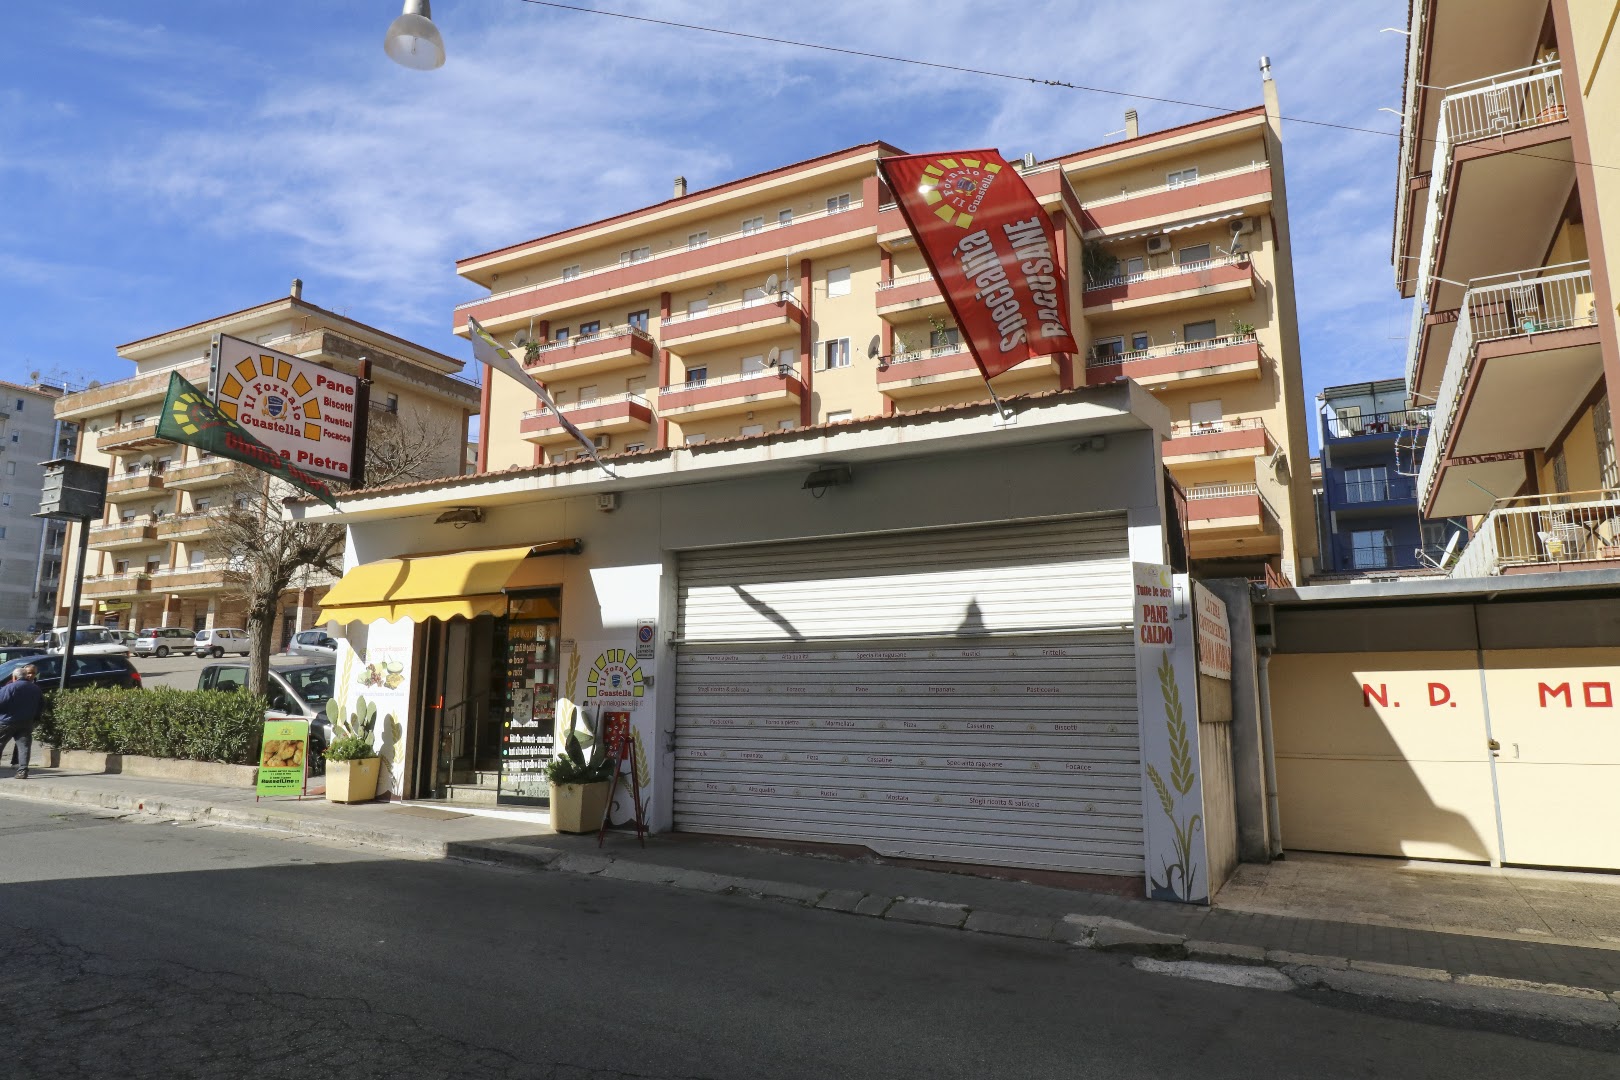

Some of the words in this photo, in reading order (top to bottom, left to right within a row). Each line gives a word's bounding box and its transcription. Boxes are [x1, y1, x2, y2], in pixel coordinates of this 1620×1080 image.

[944, 168, 980, 198] Fornaio
[968, 174, 995, 213] Guastella
[1002, 216, 1068, 338] RAGUSANE
[316, 374, 355, 396] Pane
[243, 395, 257, 409] Il
[252, 382, 302, 421] Fornaio
[323, 396, 354, 414] Biscotti
[240, 412, 302, 438] Guastella
[324, 414, 353, 429] Rustici
[279, 448, 291, 461] a
[297, 449, 349, 473] Pietra
[1136, 584, 1152, 597] Tutte
[1152, 586, 1159, 597] le
[1159, 587, 1172, 598] sere
[1142, 604, 1169, 624] PANE
[1140, 625, 1173, 645] CALDO
[604, 665, 632, 686] Fornaio
[598, 689, 632, 697] Guastella
[1362, 683, 1400, 708] N.
[1427, 682, 1457, 708] D.
[1537, 681, 1614, 708] MO
